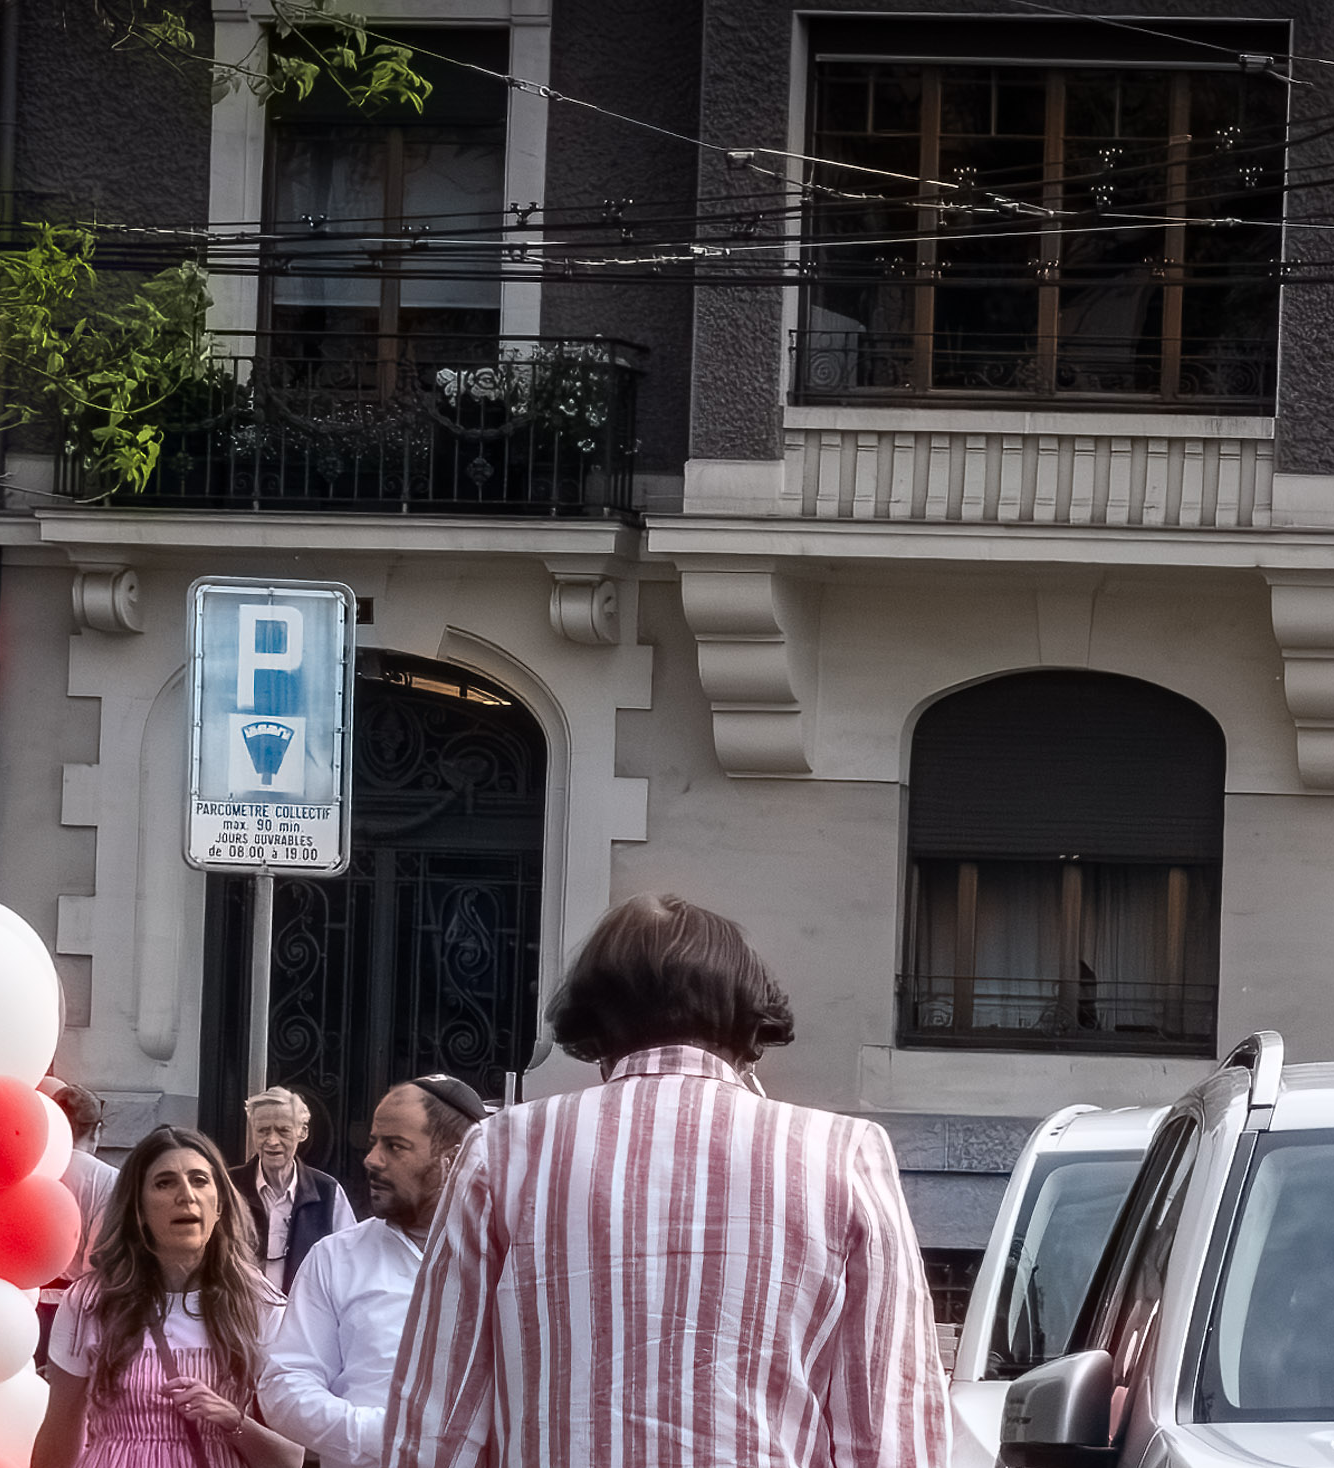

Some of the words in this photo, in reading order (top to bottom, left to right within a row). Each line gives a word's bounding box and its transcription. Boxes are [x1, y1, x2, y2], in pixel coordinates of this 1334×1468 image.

[237, 604, 304, 711] P
[275, 805, 332, 820] COLLECTIF
[257, 819, 272, 832] 90
[215, 833, 248, 845] JOURS
[254, 834, 314, 847] OUVRABLES
[208, 844, 222, 858] de
